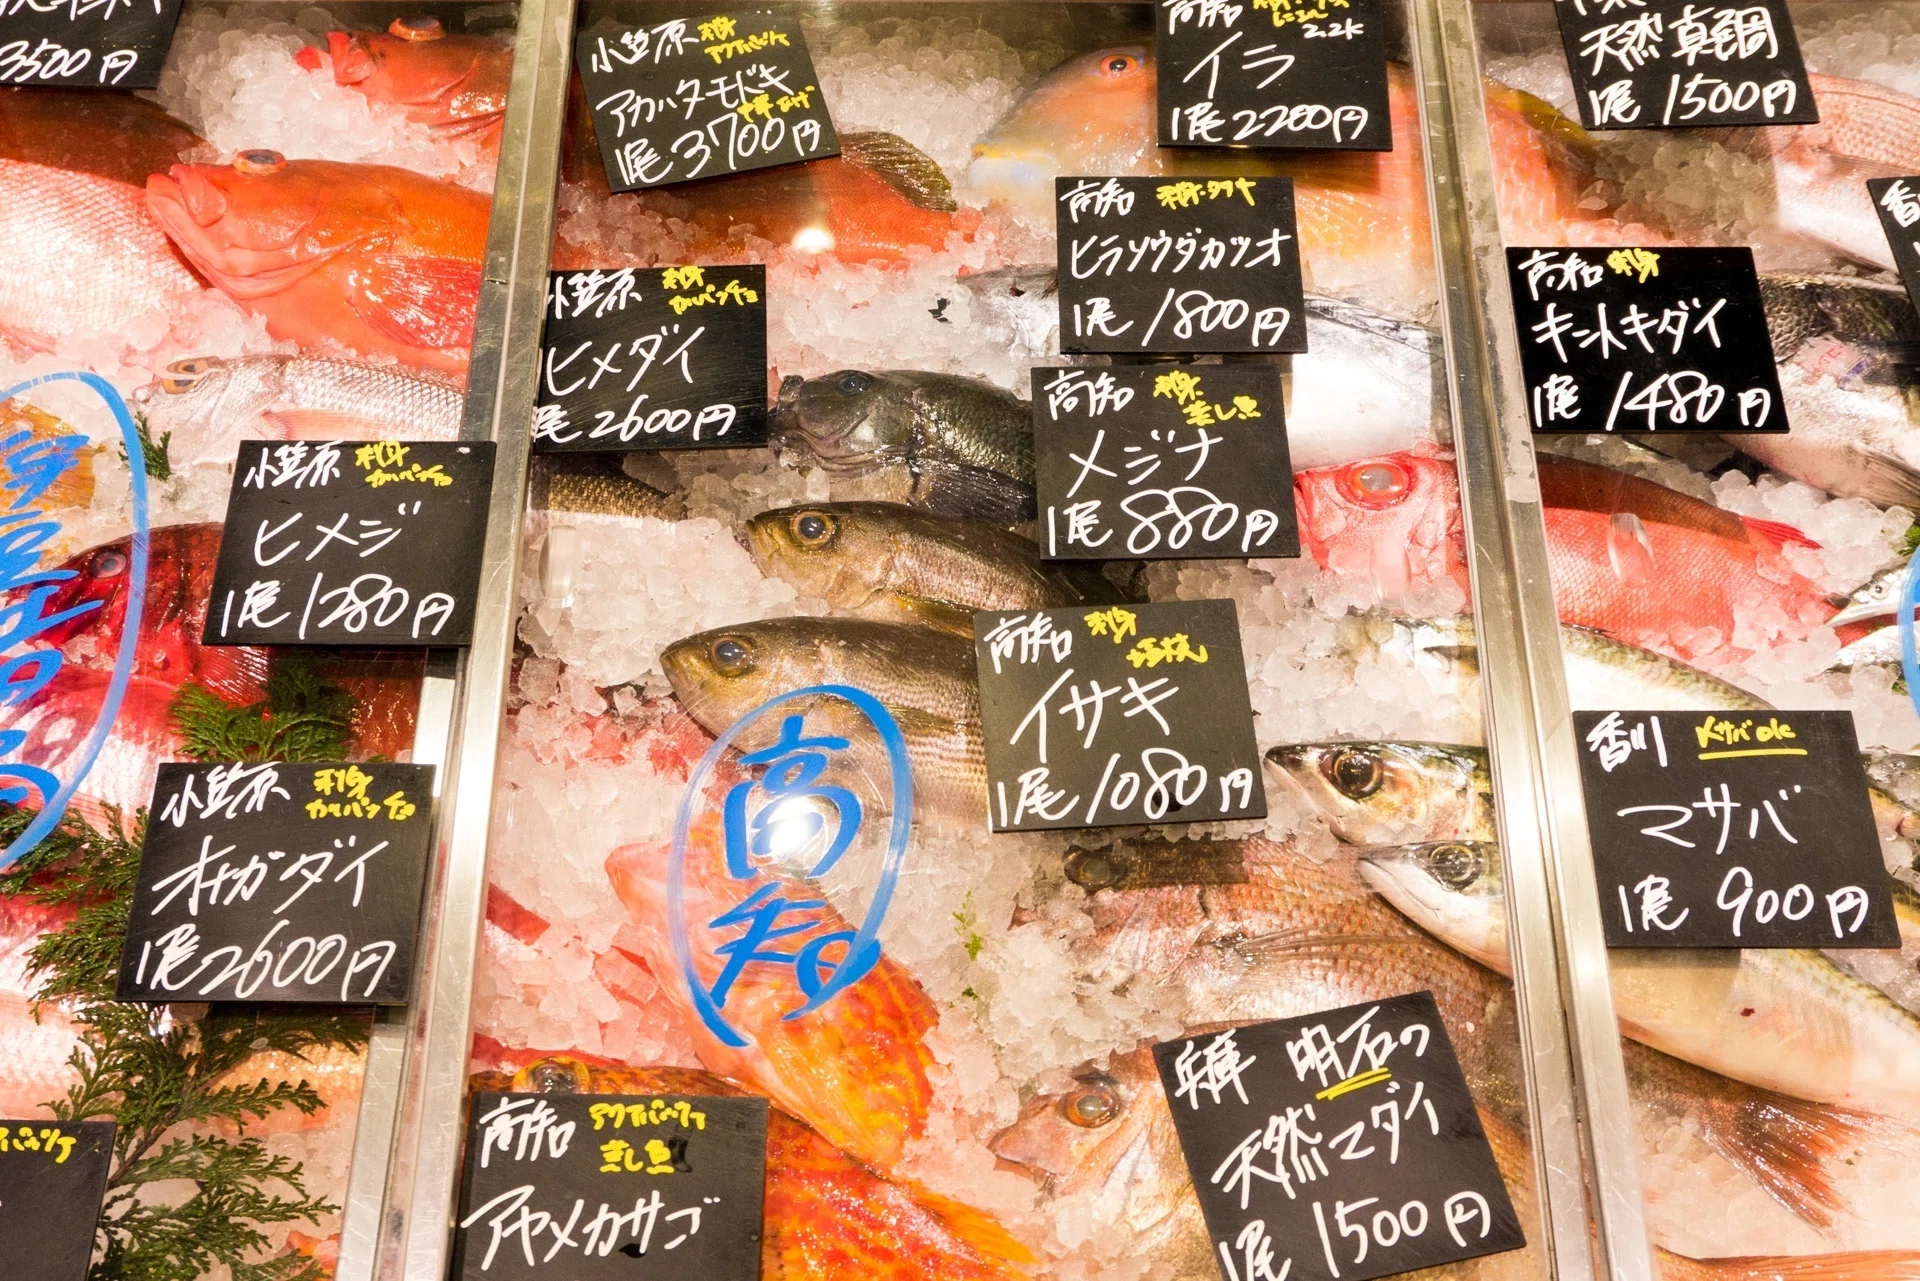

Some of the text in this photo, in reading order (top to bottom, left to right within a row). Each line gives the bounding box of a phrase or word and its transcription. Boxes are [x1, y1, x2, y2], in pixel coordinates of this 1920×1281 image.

[592, 18, 700, 73] 小笠原
[1182, 31, 1296, 100] イラ
[595, 64, 795, 138] アカハタモドキ
[1059, 177, 1135, 223] 高知
[1880, 178, 1920, 228] 香
[1071, 227, 1292, 279] ヒラソウダカツオ
[1517, 250, 1604, 301] 高知
[546, 323, 706, 397] ヒメダイ
[1531, 297, 1727, 364] キントキダイ
[1043, 369, 1135, 421] 高知
[242, 440, 344, 490] 小笠原
[1066, 428, 1224, 499] メジナ
[254, 500, 422, 567] ヒメジ
[983, 611, 1073, 675] 高知
[1009, 668, 1180, 764] イサキ
[1585, 711, 1669, 773] 香川
[159, 761, 375, 828] 小笠原 刺身
[1616, 783, 1802, 856] マサバ
[151, 834, 390, 917] オナガダイ
[479, 1097, 577, 1169] 高知
[460, 1184, 722, 1271] アヤメカサゴ
